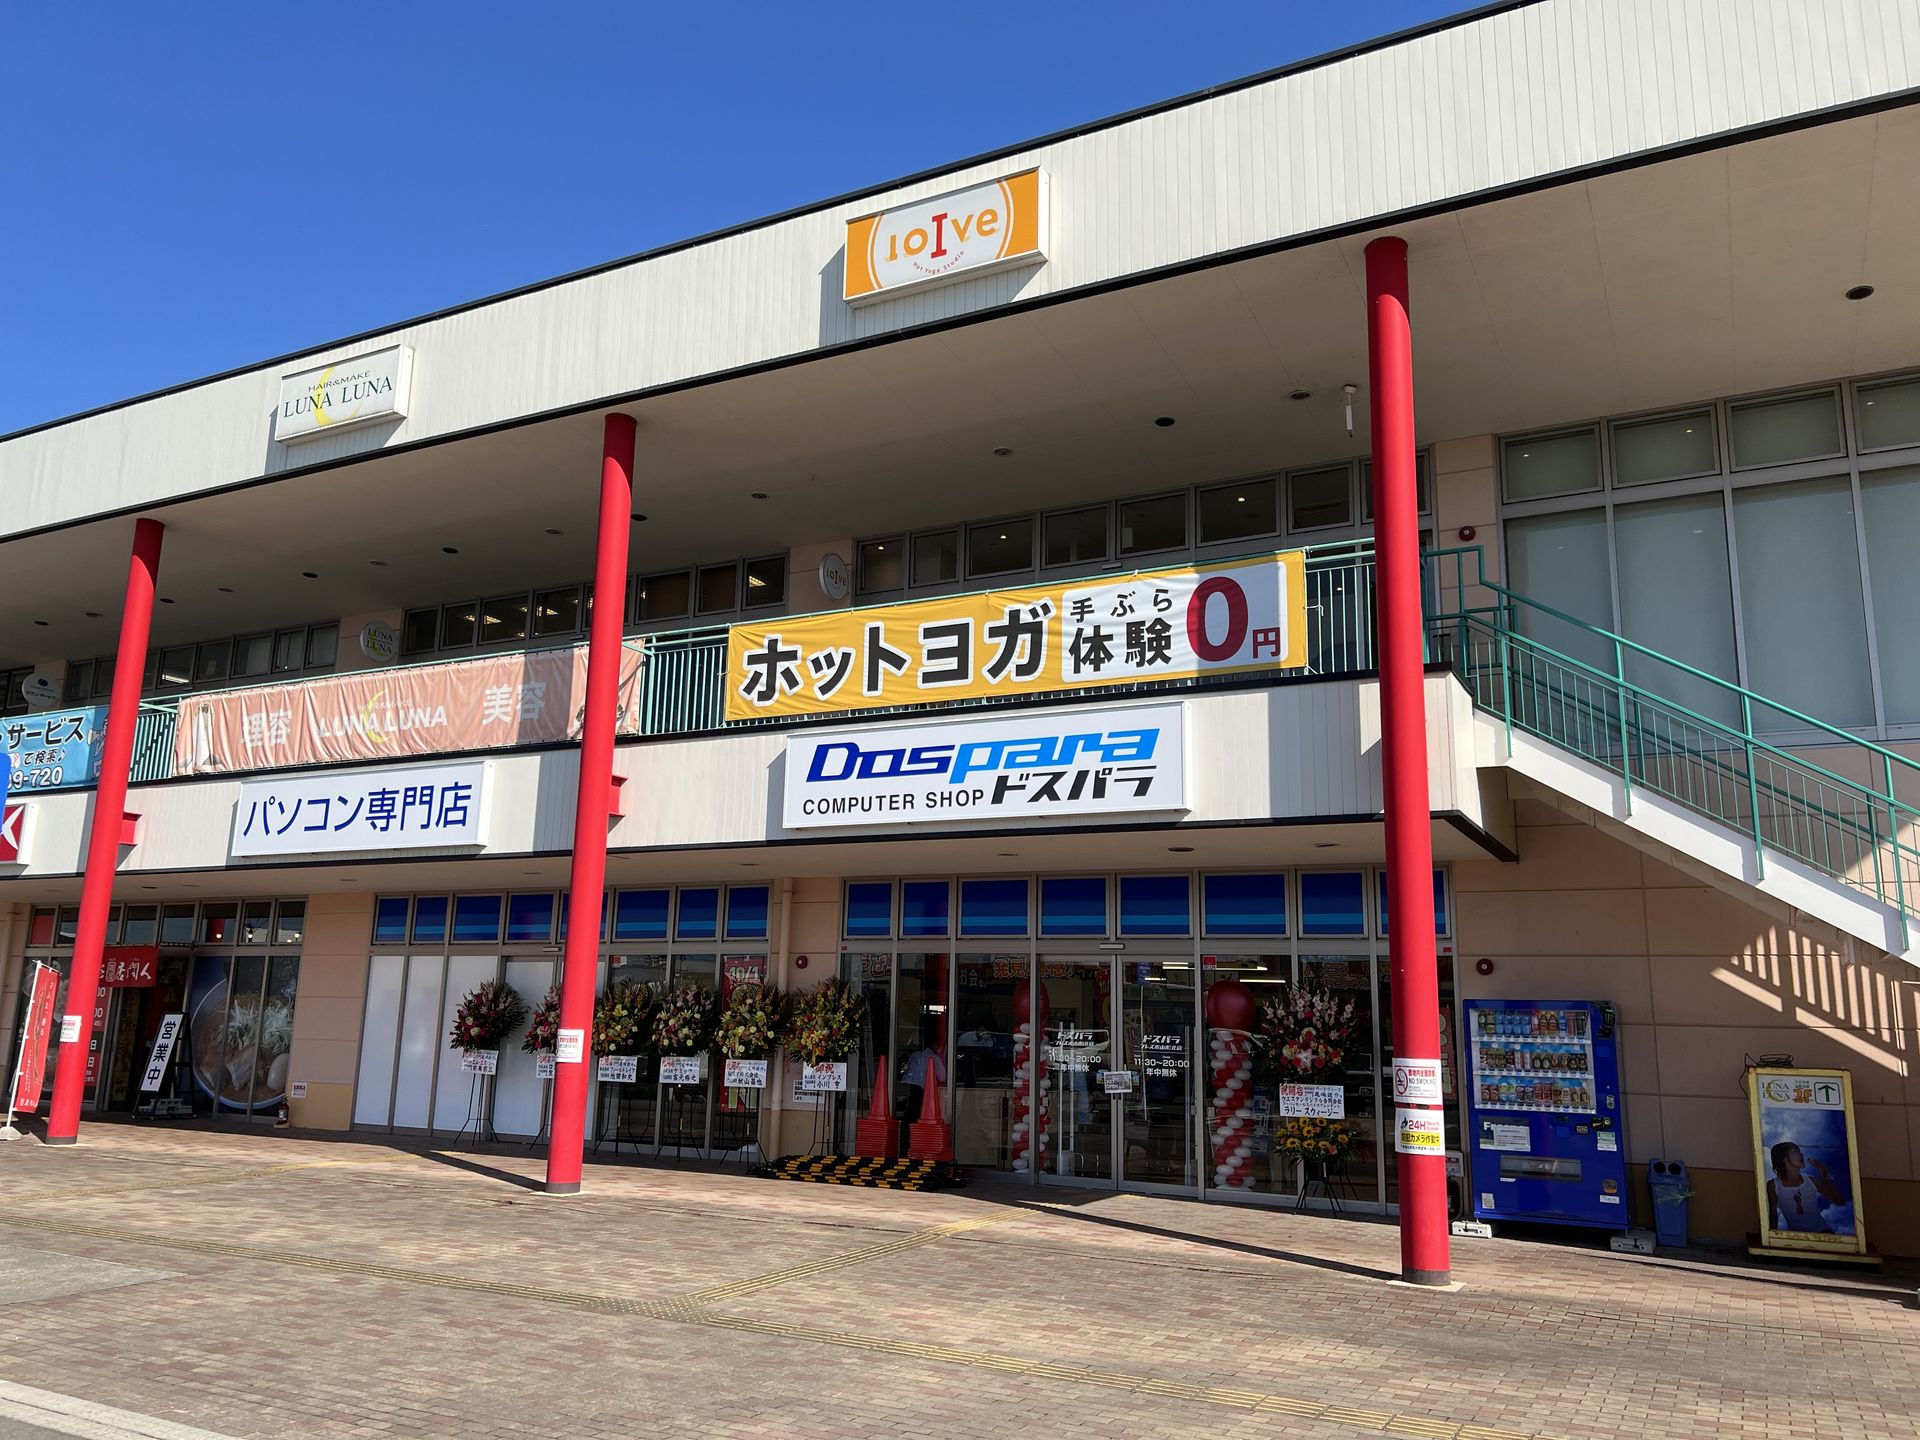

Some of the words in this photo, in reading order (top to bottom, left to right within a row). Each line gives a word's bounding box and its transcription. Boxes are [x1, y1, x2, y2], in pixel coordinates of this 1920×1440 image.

[912, 261, 923, 272] Hot
[924, 267, 941, 275] Yoga
[943, 250, 965, 271] Studio
[308, 370, 371, 393] HAIR&MAKE
[284, 392, 332, 418] LUNA
[341, 376, 393, 404] LUNA
[1070, 588, 1173, 623] 手ぶら
[367, 627, 393, 642] LUNA
[1068, 617, 1173, 674] 体験
[1186, 576, 1281, 662] 0円
[366, 639, 392, 654] LUNA
[741, 600, 1054, 704] ホットヨガ
[482, 680, 547, 726] 美容
[242, 709, 293, 748] 理容
[319, 714, 379, 738] LUNA
[383, 706, 448, 732] LUNA
[806, 728, 1160, 784] Dospara
[991, 765, 1157, 804] ドスパラ
[243, 781, 473, 838] パソコン専門店
[803, 793, 915, 815] COMPUTER
[925, 789, 984, 809] SHOP
[1057, 1032, 1094, 1040] ドスパラ
[1143, 1035, 1181, 1043] ドスパラ
[148, 1021, 176, 1085] 営業中
[1060, 1064, 1090, 1073] 年中無休
[1146, 1068, 1178, 1077] 年中無休
[1284, 1107, 1302, 1115] ラリー
[1304, 1107, 1340, 1116] スウィージー
[1408, 1119, 1426, 1130] 24H
[1401, 1132, 1440, 1143] 防犯カメラ作動中
